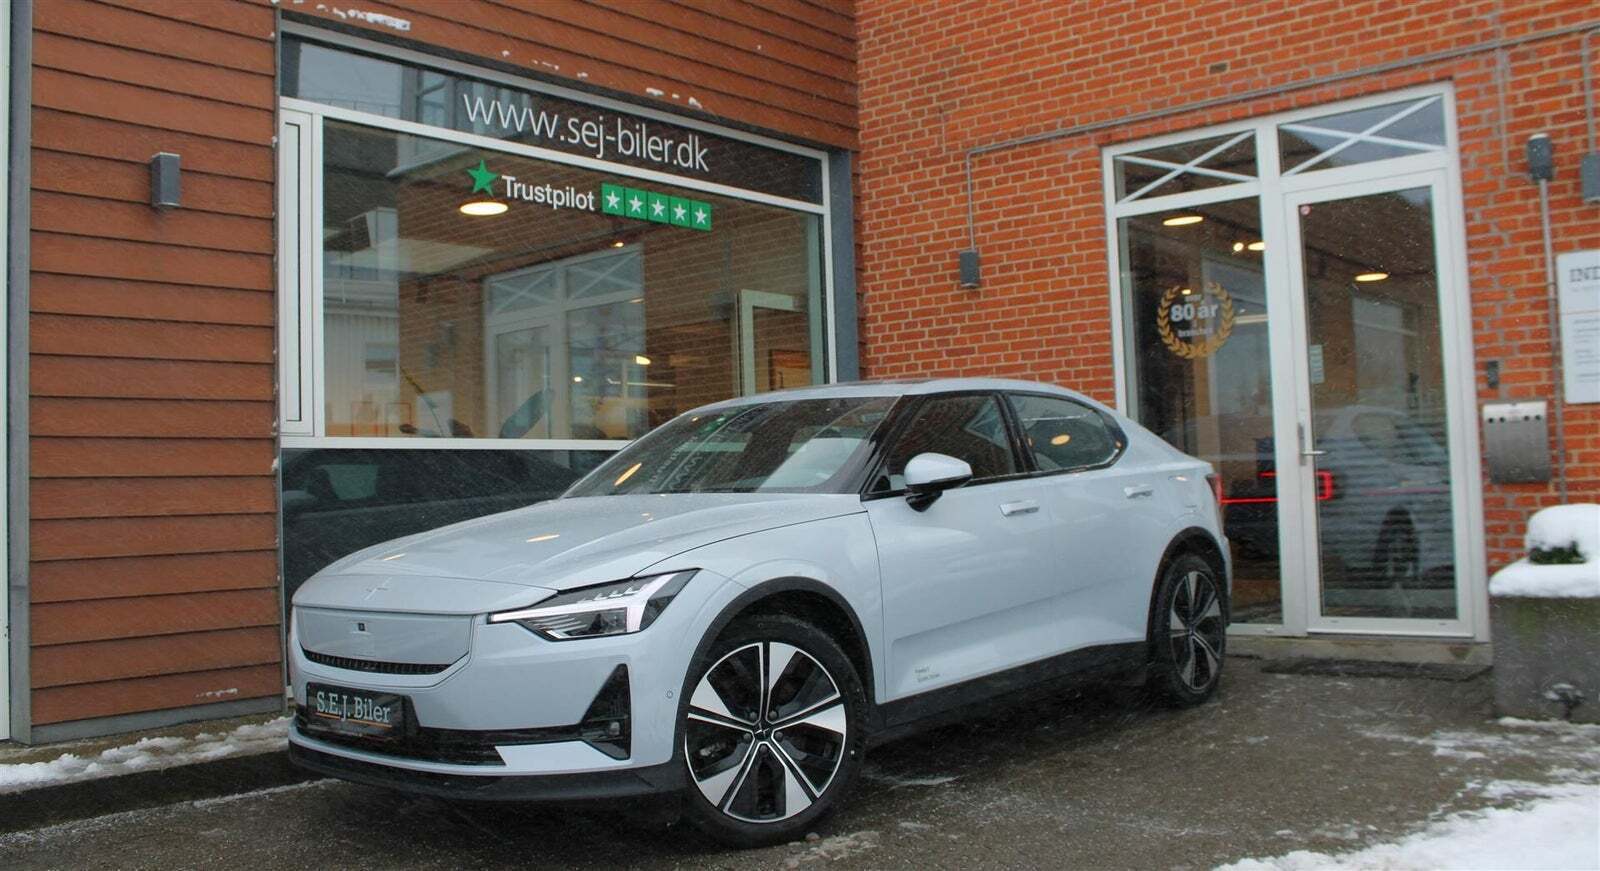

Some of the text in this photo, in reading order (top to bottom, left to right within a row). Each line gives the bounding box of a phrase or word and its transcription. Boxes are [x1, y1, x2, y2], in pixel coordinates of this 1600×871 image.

[464, 94, 709, 172] www.sej-biler.dk
[501, 175, 596, 211] Trustpilot
[1170, 304, 1195, 322] 80
[316, 691, 391, 722] S.E.J. Biler
